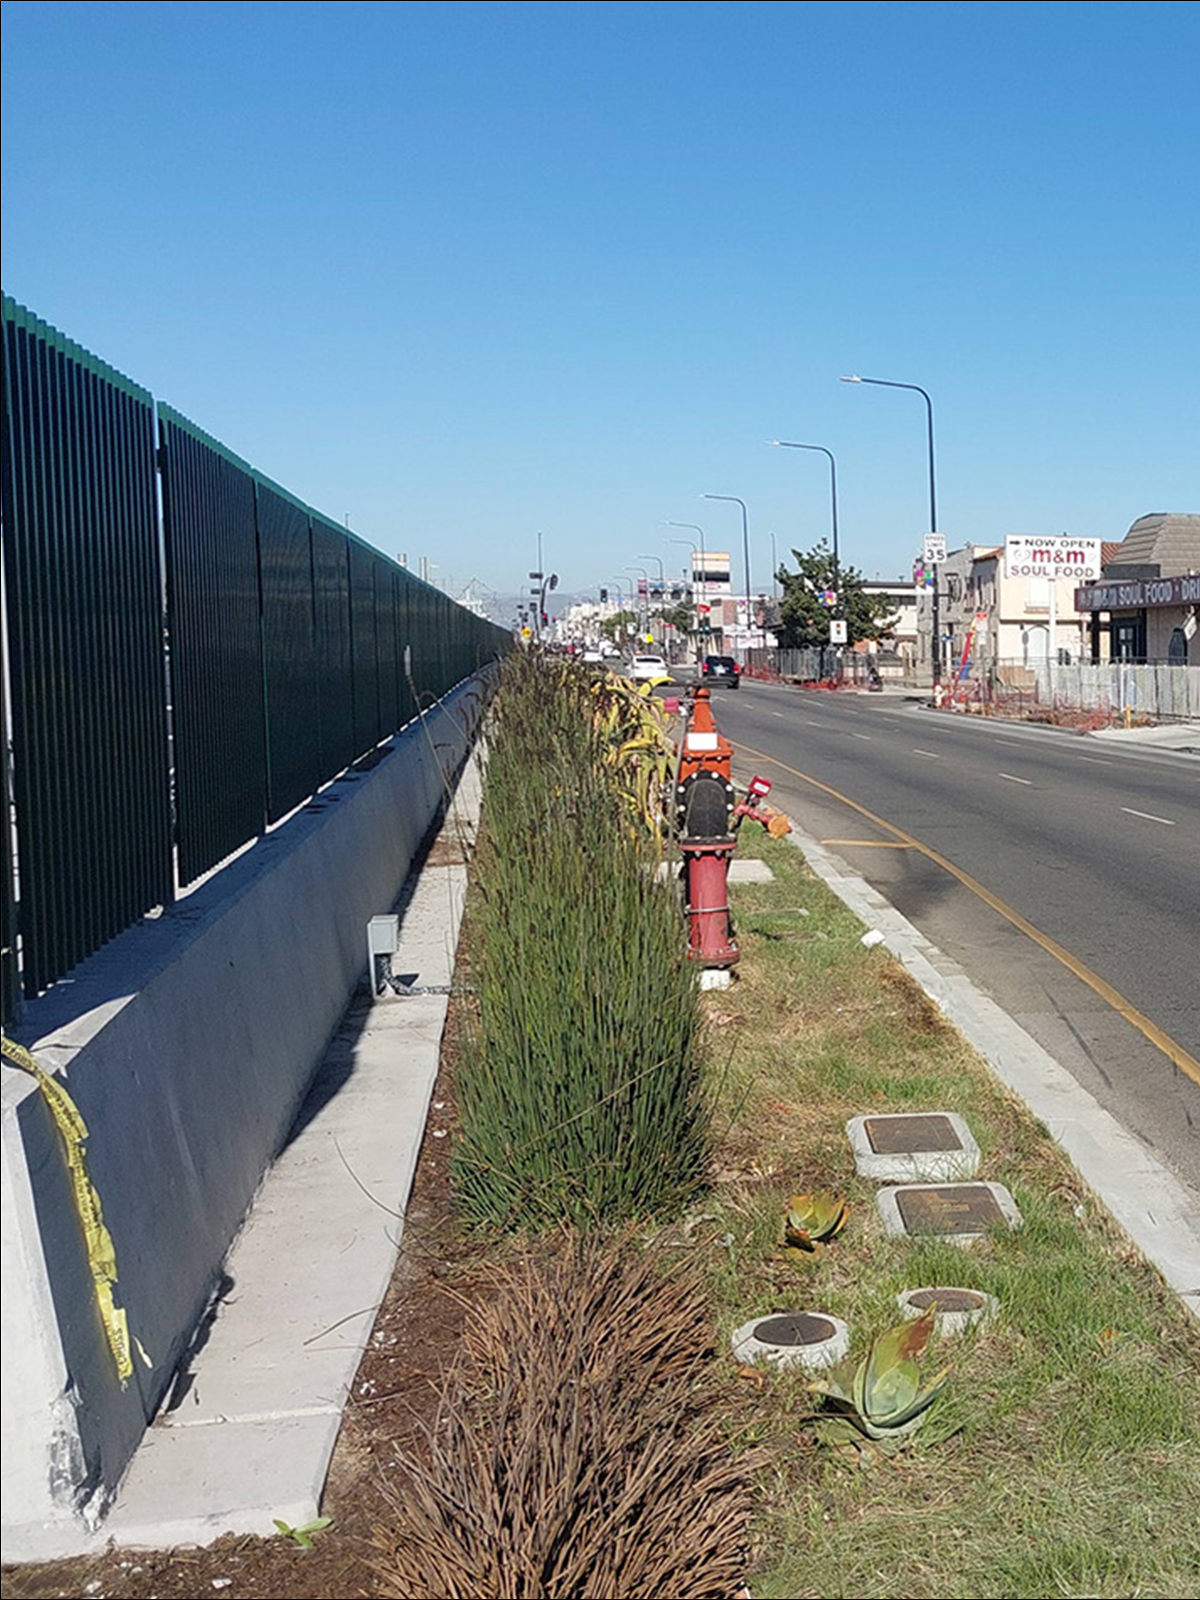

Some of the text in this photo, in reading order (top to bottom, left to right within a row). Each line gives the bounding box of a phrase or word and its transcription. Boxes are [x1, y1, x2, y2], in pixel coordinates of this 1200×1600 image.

[1025, 539, 1096, 549] NOW OPEN
[927, 549, 945, 561] 35
[1032, 549, 1086, 564] m&m
[1011, 565, 1095, 577] SOUL FOOD
[1145, 581, 1173, 603] FOOD
